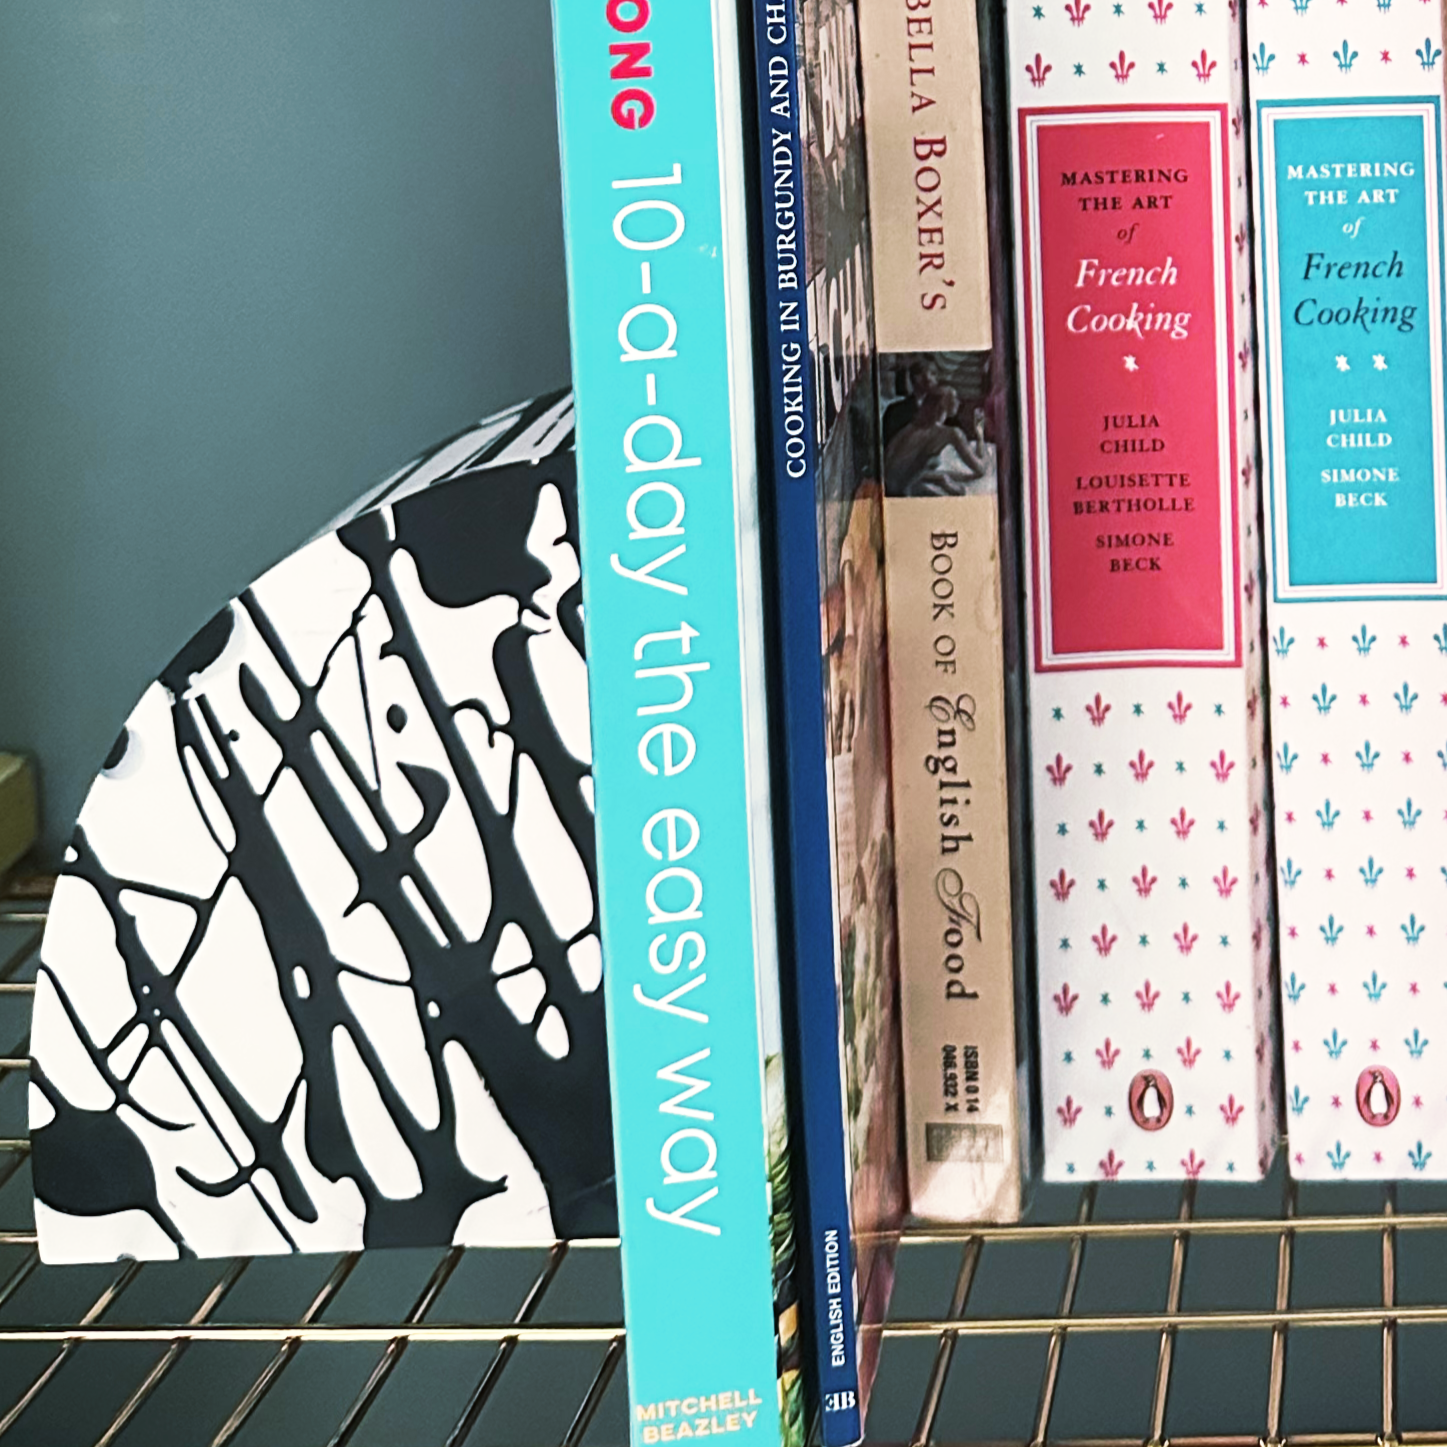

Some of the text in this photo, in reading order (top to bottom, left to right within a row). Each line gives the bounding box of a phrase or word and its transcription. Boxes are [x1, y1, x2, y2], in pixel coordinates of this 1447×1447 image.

[768, 55, 791, 118] AND
[1061, 169, 1188, 186] MASTERING
[1287, 162, 1415, 179] MASTERING
[1079, 195, 1173, 211] THE ART
[1304, 189, 1399, 205] THE ART
[770, 128, 799, 291] BURGUNDY
[912, 135, 956, 311] BOXER'S
[1117, 223, 1139, 244] of
[1342, 216, 1366, 238] of
[1075, 256, 1178, 288] French
[1303, 250, 1404, 280] French
[780, 300, 800, 332] IN
[1067, 302, 1192, 339] Cooking
[1293, 296, 1418, 334] Cooking
[781, 342, 807, 479] COOKING
[1329, 408, 1387, 426] JULIA
[1103, 414, 1160, 431] JULIA
[1099, 438, 1165, 453] CHILD
[1326, 432, 1392, 447] CHILD
[1076, 473, 1191, 490] LOUISETTE
[1320, 467, 1400, 483] SIMONE
[1073, 498, 1195, 515] BERTHOLLE
[1335, 492, 1388, 507] BECK
[1095, 532, 1175, 548] SIMONE
[1109, 557, 1161, 572] BECK
[610, 163, 721, 1236] 10-a-day the easy way
[924, 530, 982, 1002] BOOK OF English Food
[963, 1045, 979, 1082] ISBN
[945, 1103, 959, 1112] X
[966, 1097, 979, 1113] 14
[825, 1229, 845, 1367] ENGLISH EDITION
[636, 1388, 762, 1422] MITCHELL
[643, 1410, 758, 1445] BEAZLEY
